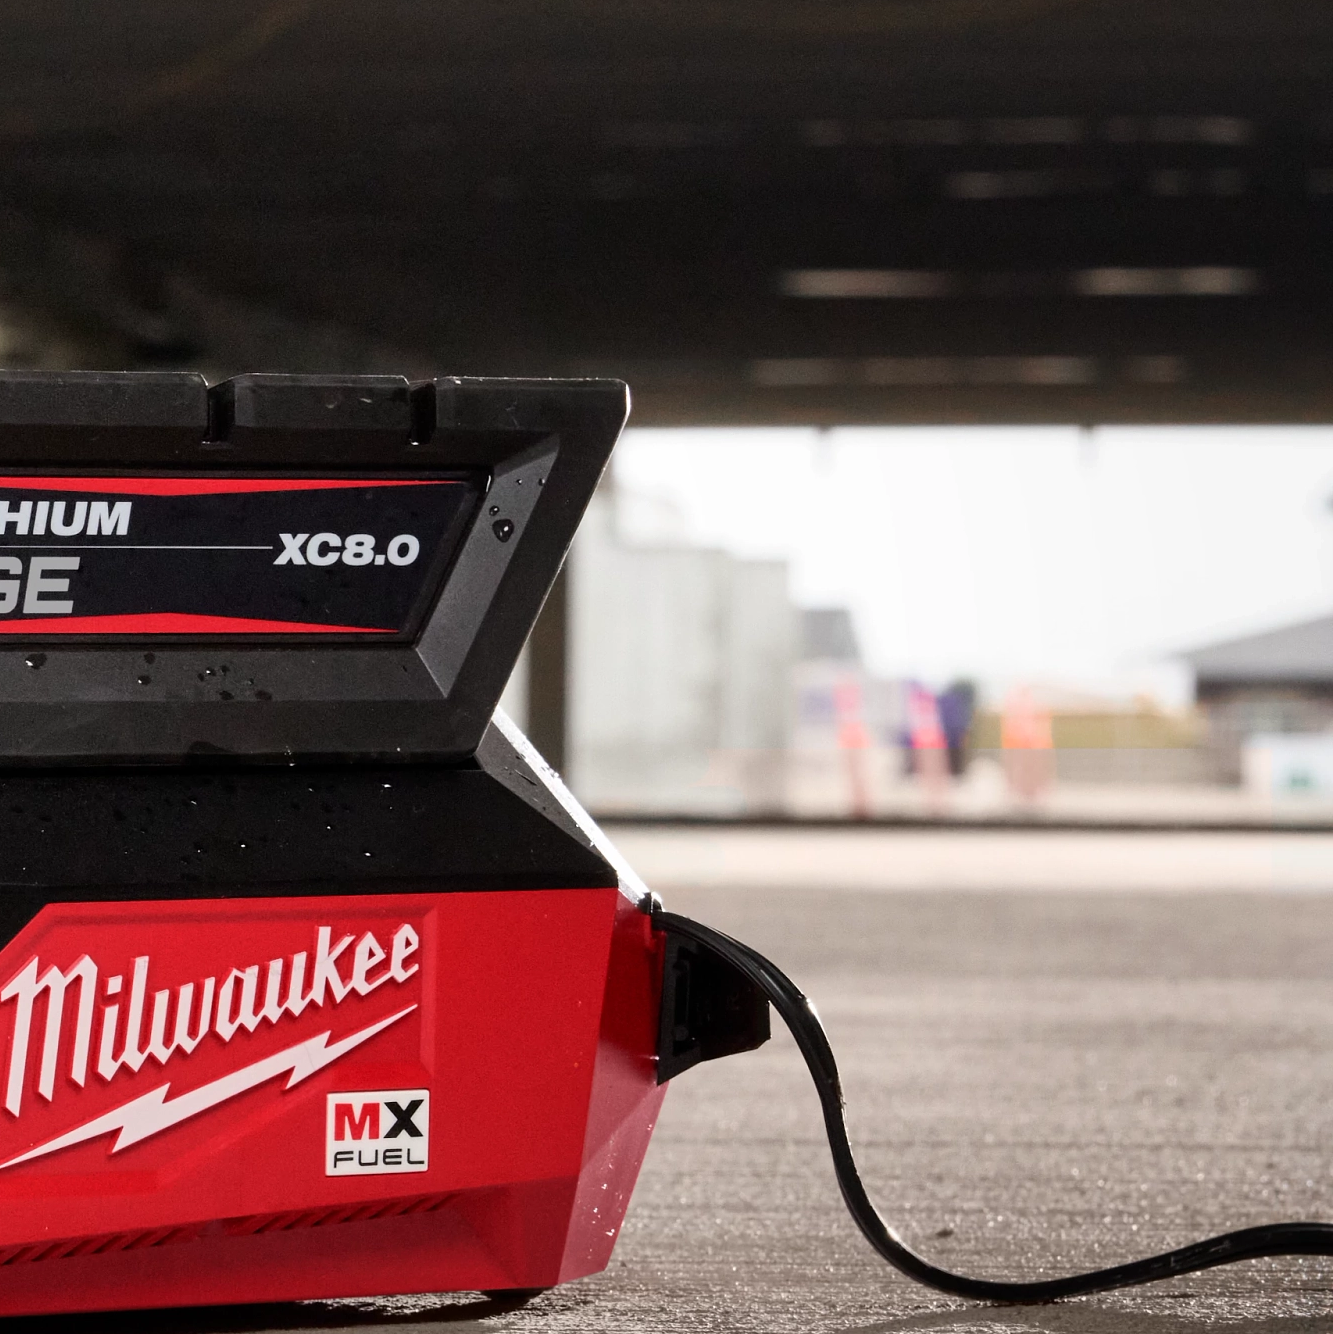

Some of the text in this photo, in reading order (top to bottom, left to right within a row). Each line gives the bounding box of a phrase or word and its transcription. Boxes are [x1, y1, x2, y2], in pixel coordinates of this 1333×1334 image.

[273, 532, 420, 566] XC8.0
[0, 922, 420, 1118] Milwaukee
[334, 1098, 425, 1141] MX
[333, 1148, 425, 1169] FUEL
